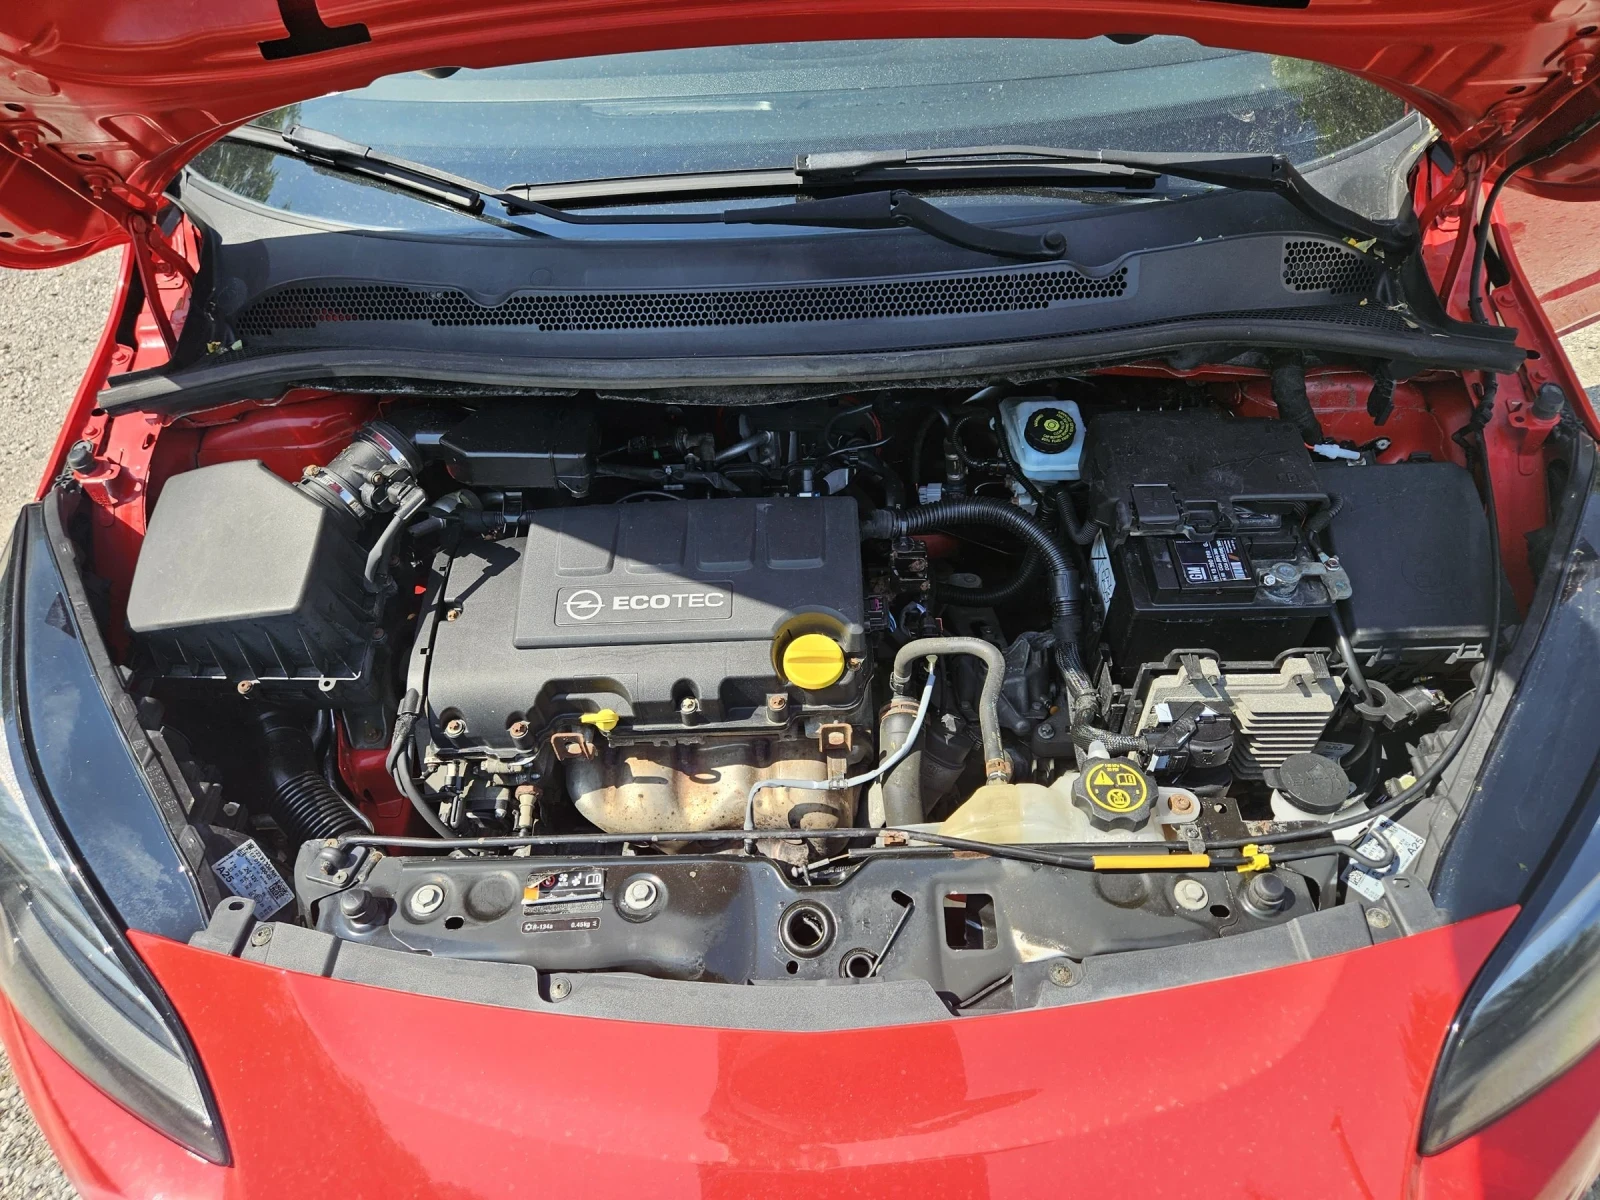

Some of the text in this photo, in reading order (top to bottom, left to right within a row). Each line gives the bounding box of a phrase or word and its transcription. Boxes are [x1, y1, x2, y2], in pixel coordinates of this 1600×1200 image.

[1187, 567, 1202, 579] GM
[613, 593, 724, 610] ECOTEC
[1406, 835, 1424, 856] A25
[216, 866, 234, 882] A25
